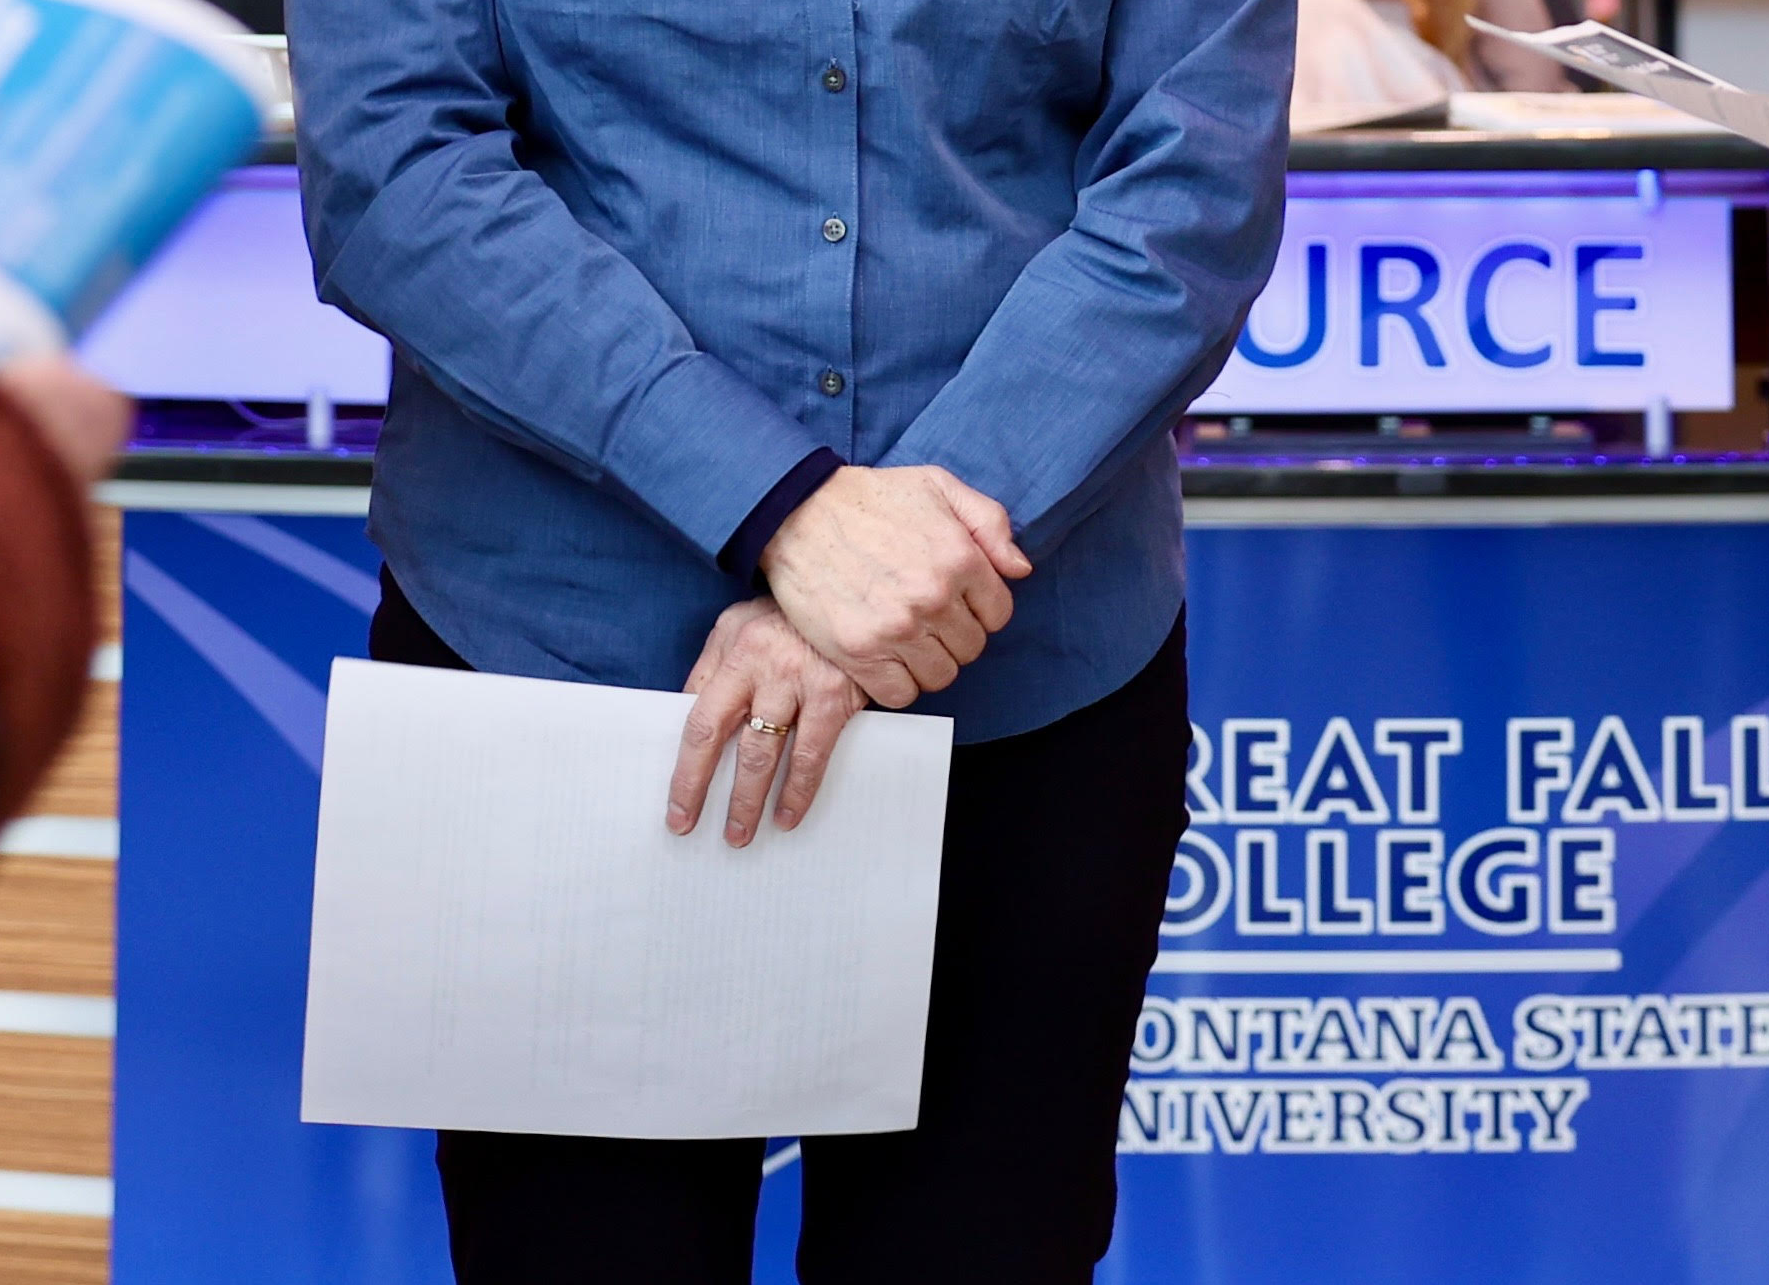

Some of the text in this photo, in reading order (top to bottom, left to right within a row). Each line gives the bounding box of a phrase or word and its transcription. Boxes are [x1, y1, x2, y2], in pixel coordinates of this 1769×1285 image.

[1235, 244, 1645, 369] URCE
[1185, 715, 1464, 825] REAT
[1158, 825, 1617, 937] OLLEGE
[1129, 994, 1505, 1074] ONTANA
[1116, 1076, 1591, 1154] NIVERSITY
